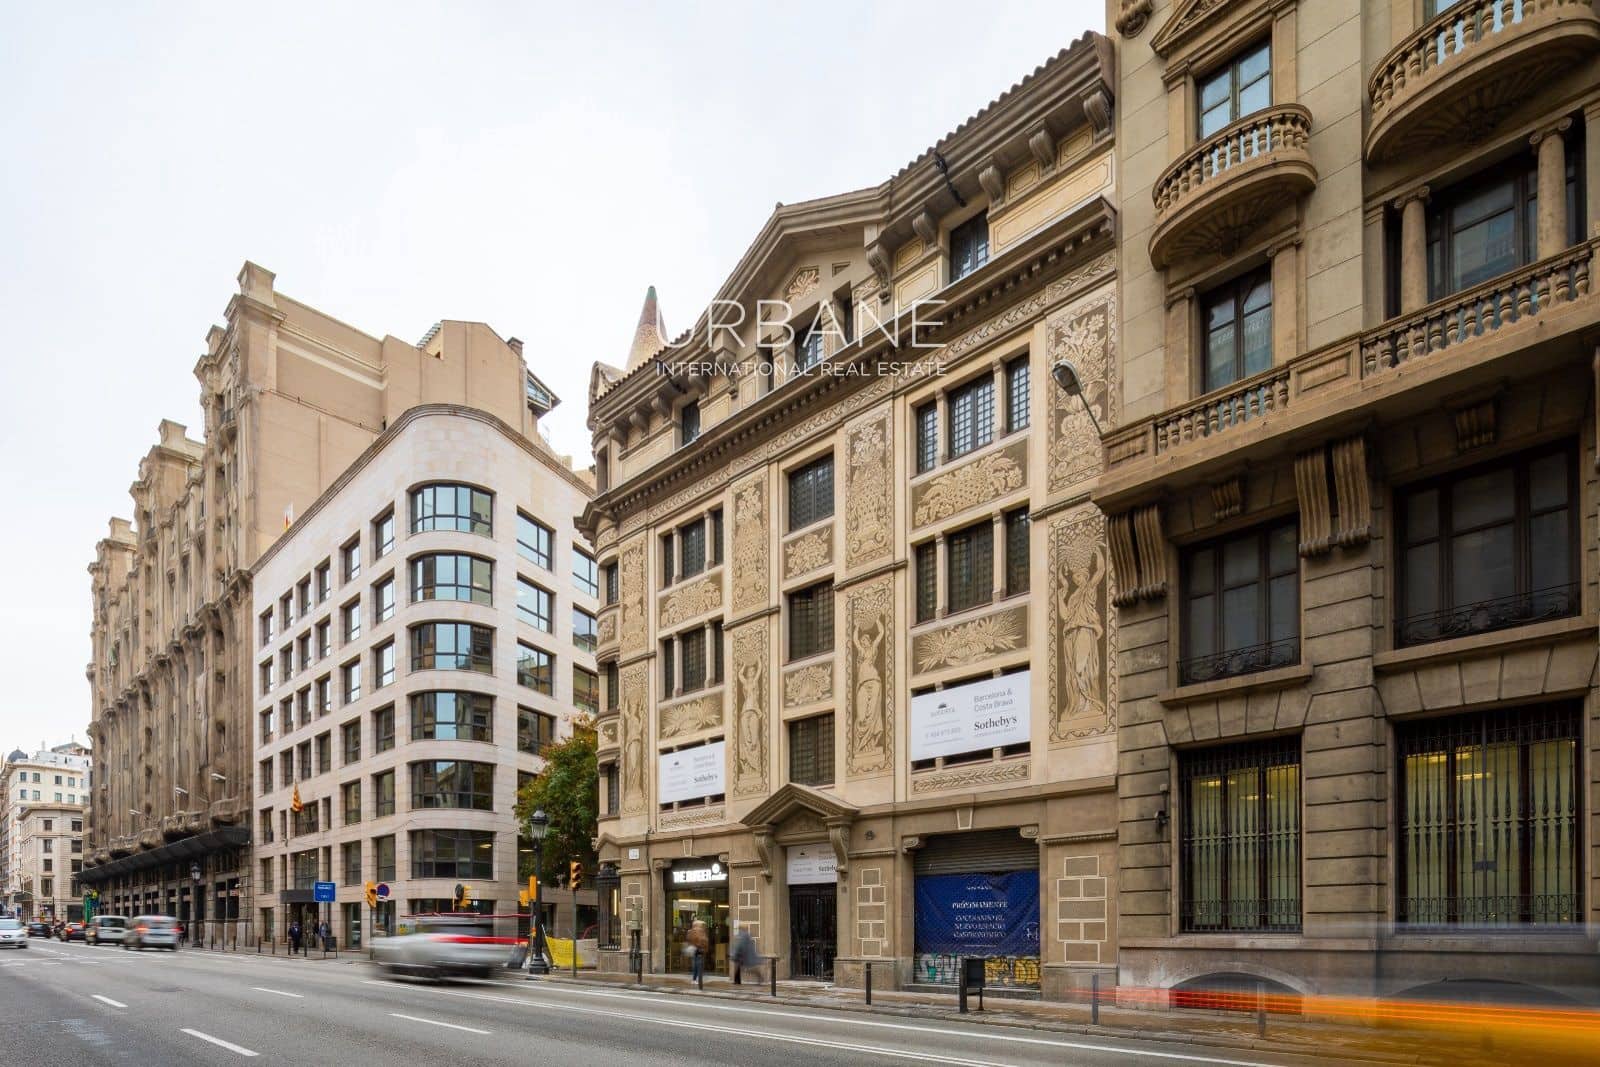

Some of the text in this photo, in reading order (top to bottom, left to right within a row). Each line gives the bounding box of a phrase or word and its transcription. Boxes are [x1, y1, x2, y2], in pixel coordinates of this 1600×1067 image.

[973, 690, 1006, 703] Barcelona
[974, 698, 1013, 712] Costa Brava
[974, 715, 1018, 731] Sotheby's
